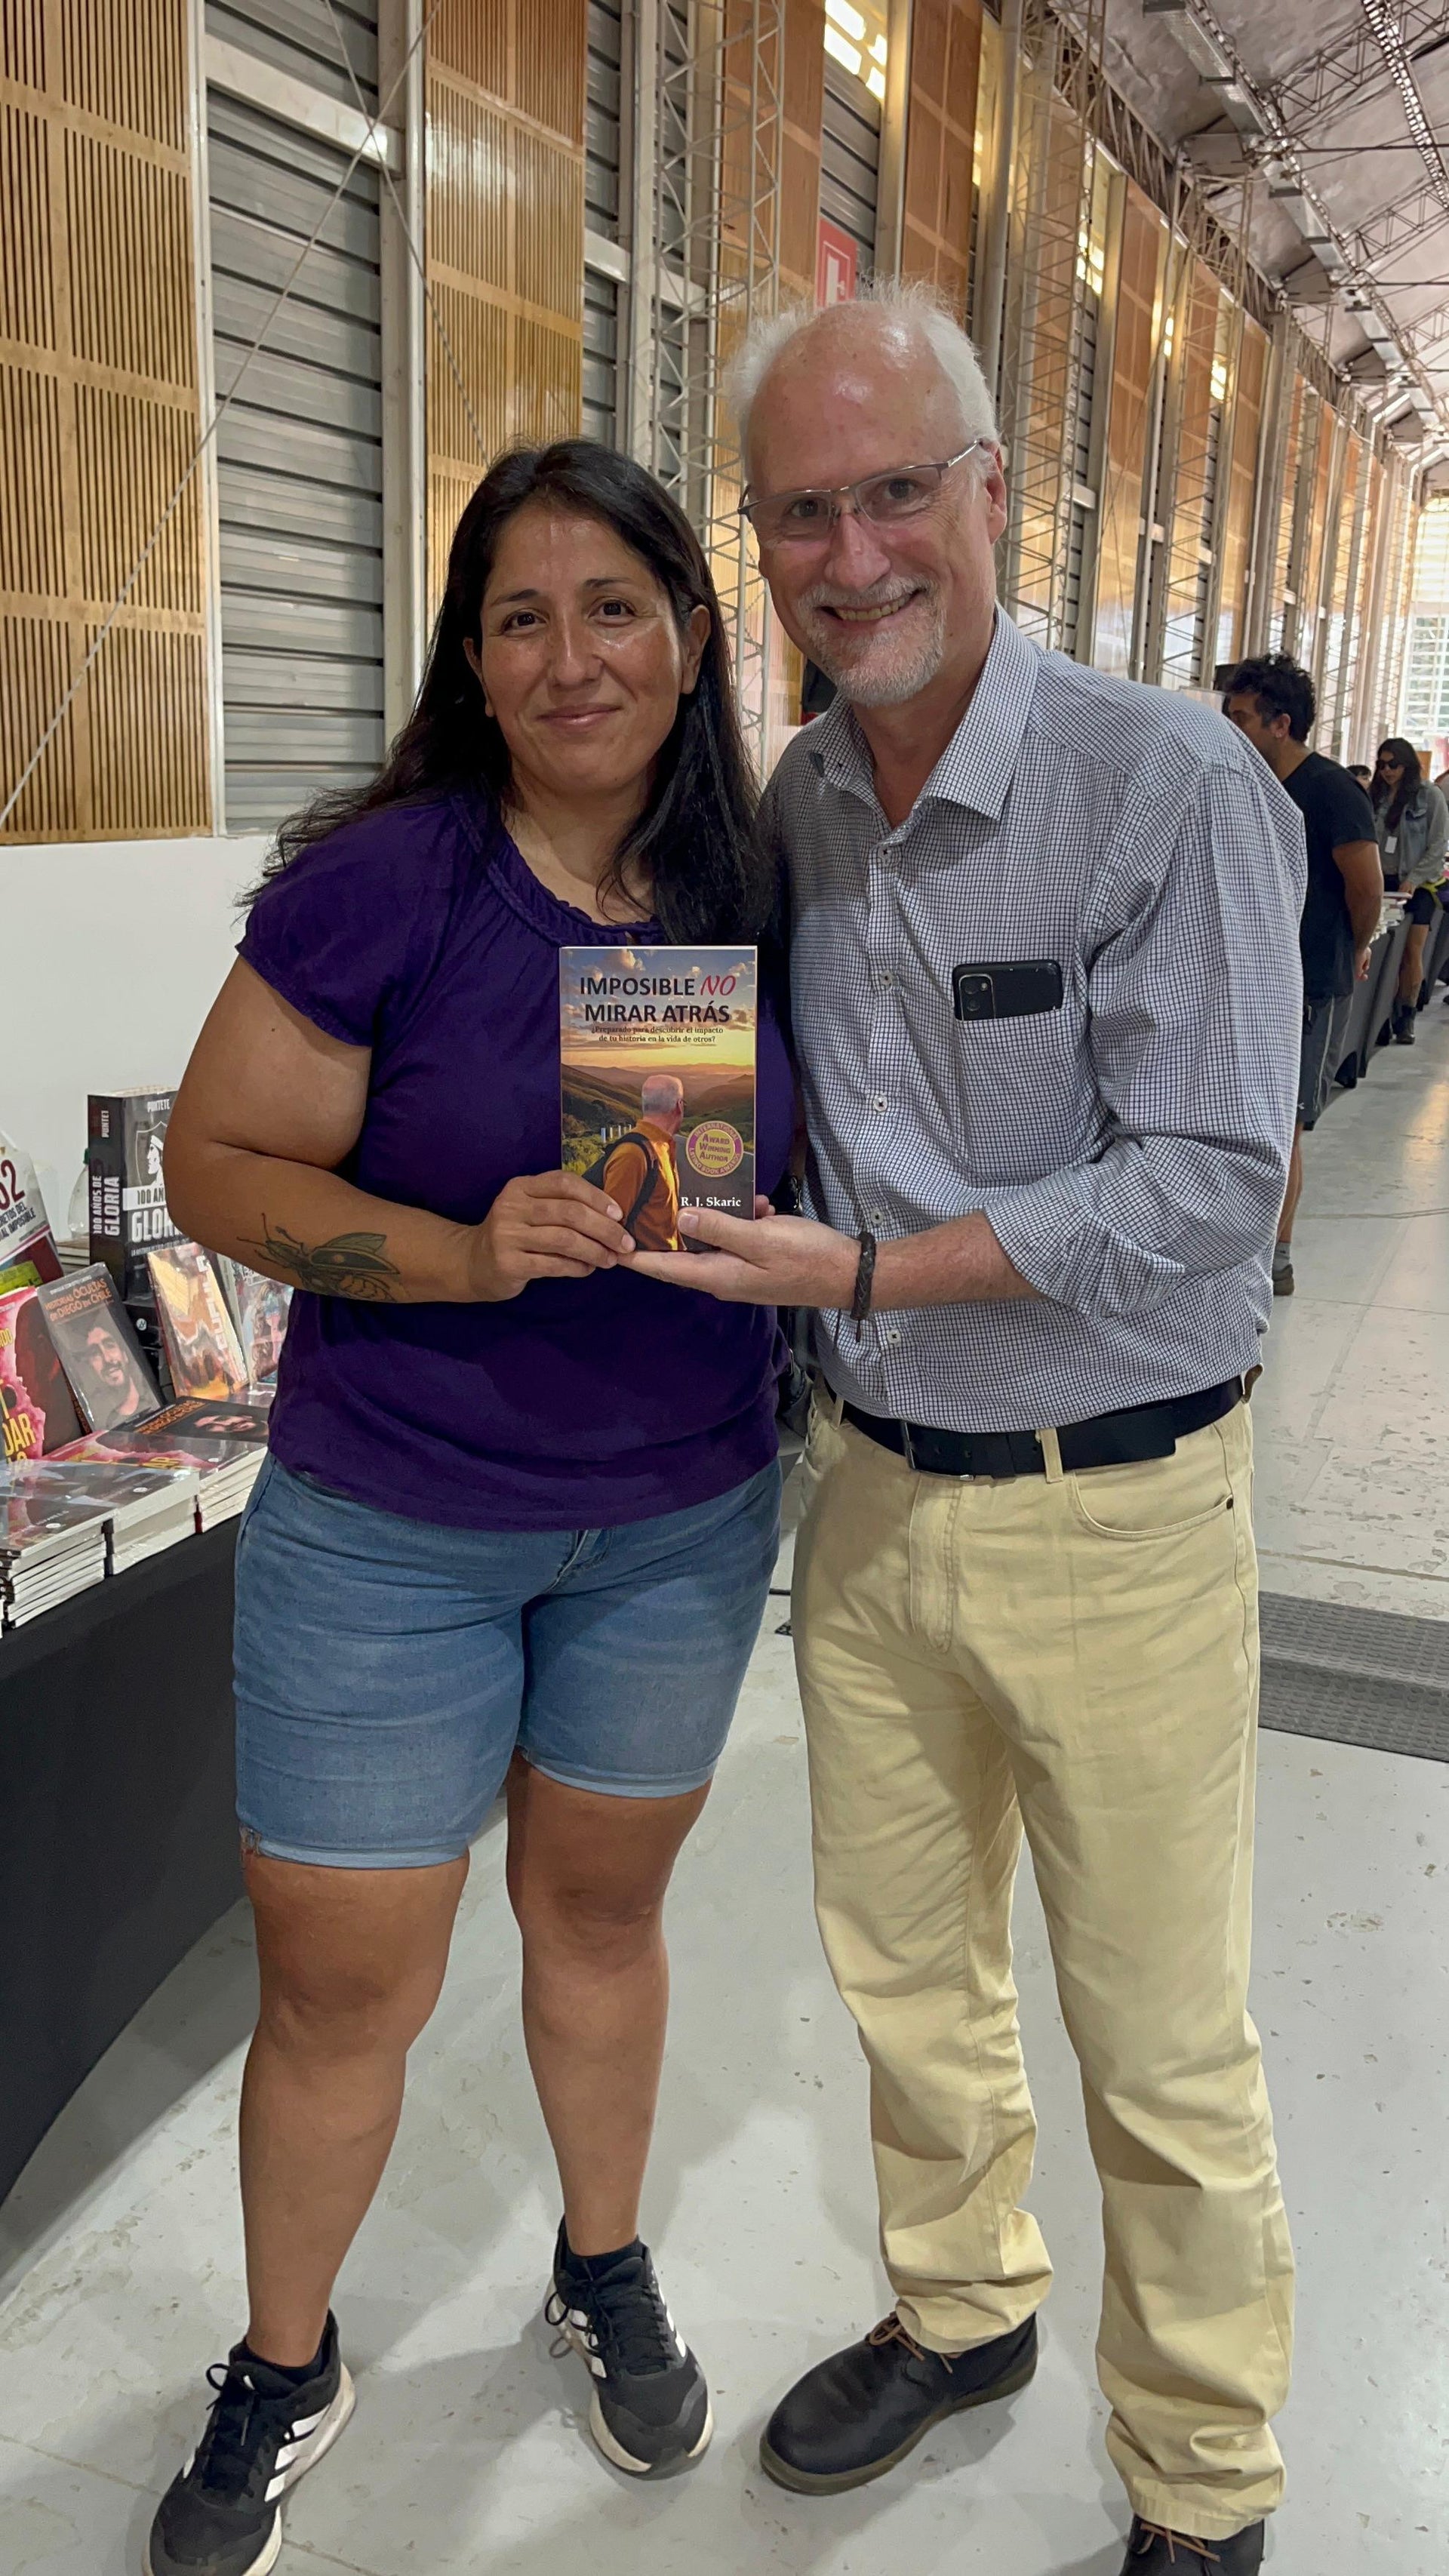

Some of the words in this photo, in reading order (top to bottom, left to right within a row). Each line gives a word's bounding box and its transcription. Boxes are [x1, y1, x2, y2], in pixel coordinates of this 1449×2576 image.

[580, 977, 695, 996] IMPOSIBLE
[700, 974, 737, 996] NO
[585, 1004, 656, 1022] MIRAR
[662, 1000, 731, 1023] ATRÁS
[93, 1176, 102, 1188] DE
[137, 1189, 151, 1205] 100
[153, 1183, 165, 1202] AÑ
[681, 1196, 692, 1207] R.
[696, 1196, 703, 1208] J.
[706, 1196, 741, 1207] Skaric
[104, 1176, 120, 1236] GLORIA
[93, 1217, 103, 1234] 100
[131, 1208, 183, 1242] GLOR
[73, 1278, 107, 1299] OCULTAS
[57, 1300, 82, 1318] DIEGO
[91, 1288, 112, 1303] CHILE
